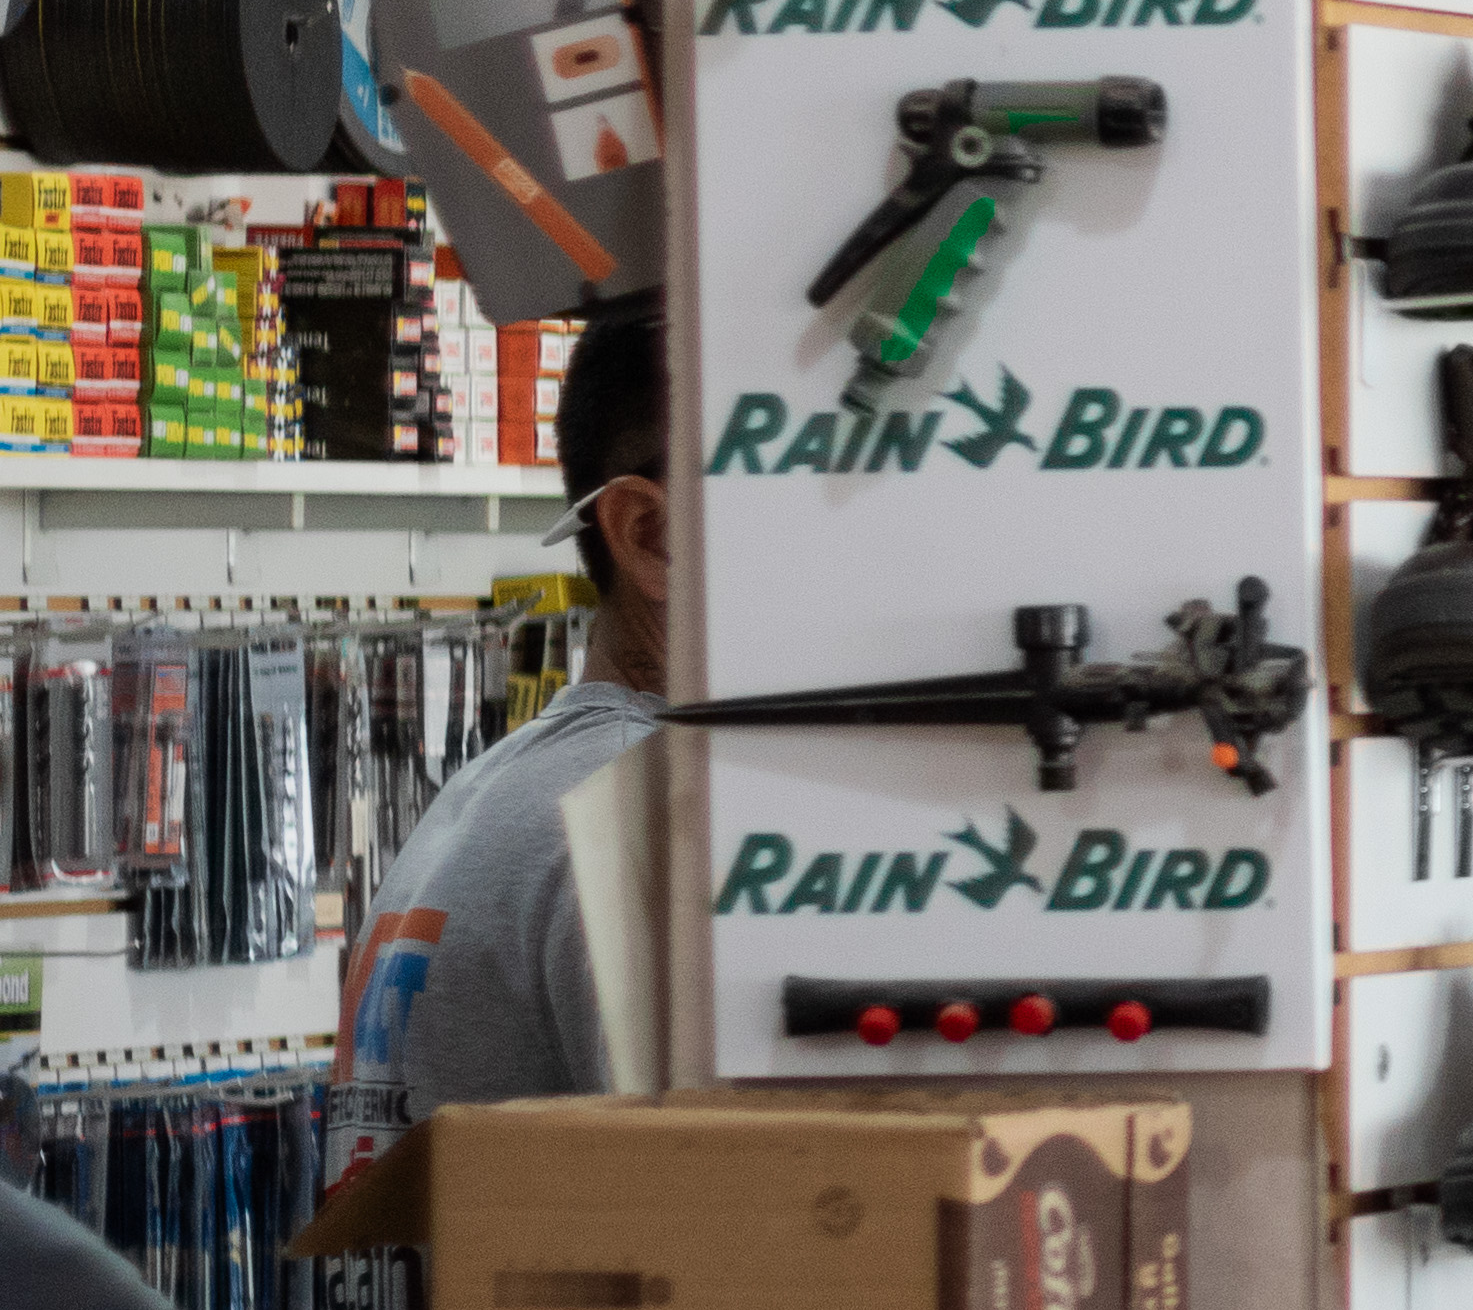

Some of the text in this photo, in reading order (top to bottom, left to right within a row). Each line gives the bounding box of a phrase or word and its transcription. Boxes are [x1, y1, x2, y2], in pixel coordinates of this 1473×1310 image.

[705, 387, 1263, 475] RAIN BIRD
[714, 829, 1271, 914] RAIN BIRD
